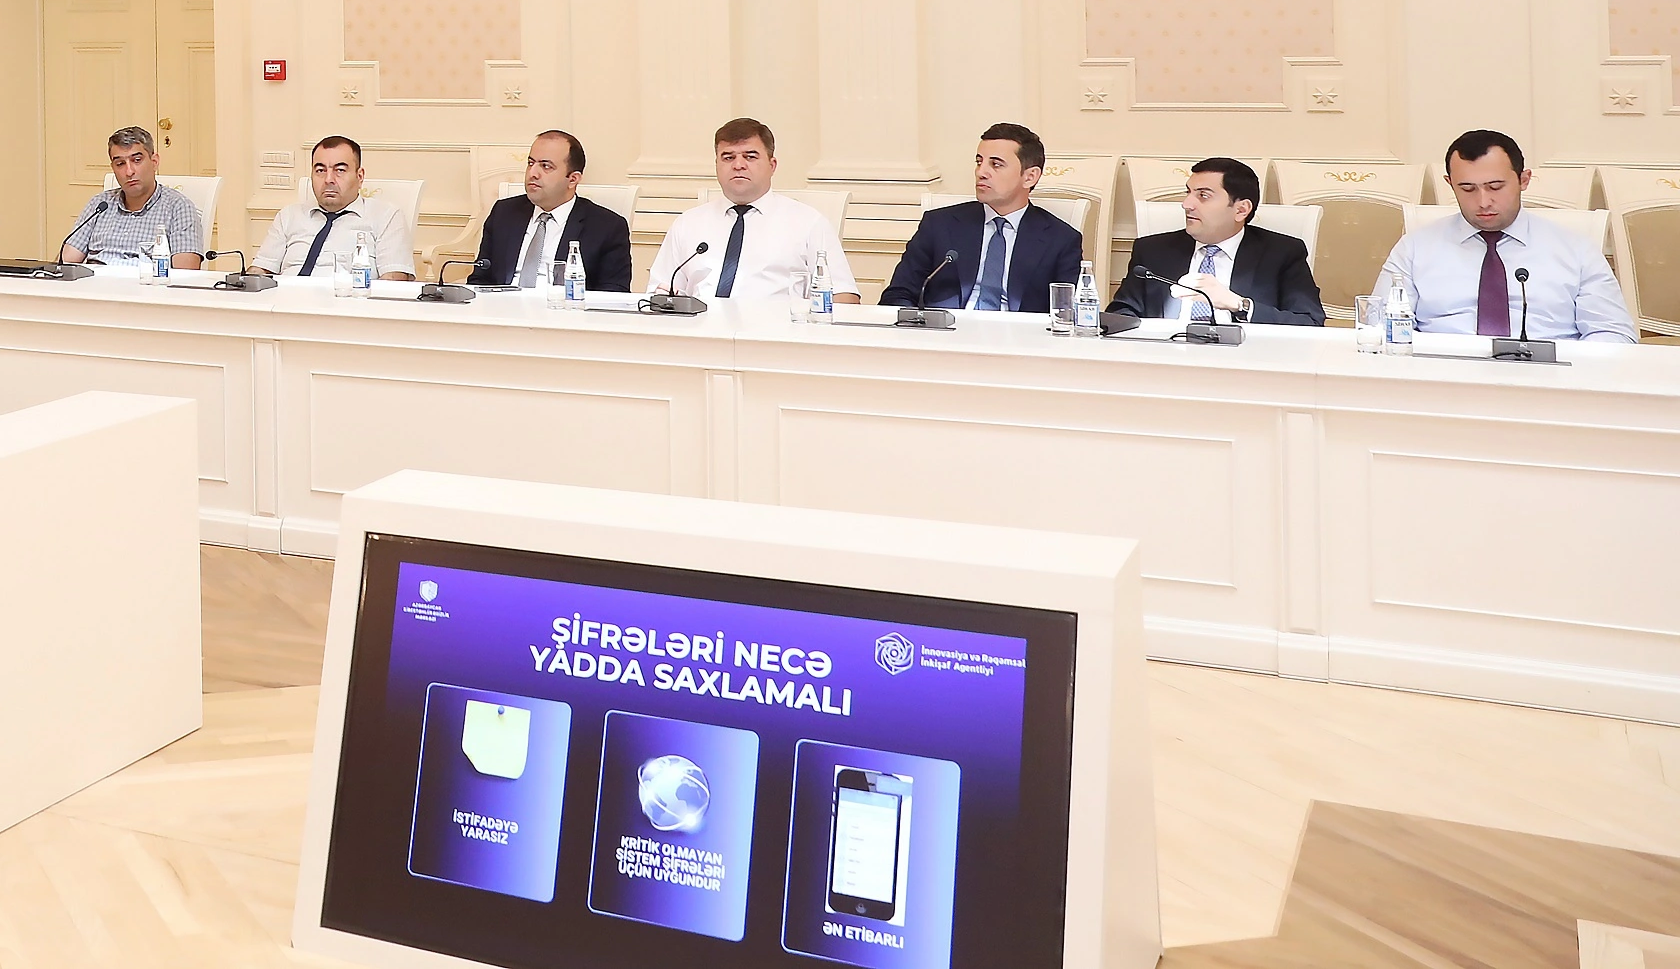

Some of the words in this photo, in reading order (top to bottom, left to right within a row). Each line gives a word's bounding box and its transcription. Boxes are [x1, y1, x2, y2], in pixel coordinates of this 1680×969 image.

[551, 612, 725, 664] ŞİFRƏLƏRİ
[734, 640, 832, 679] NECƏ
[529, 644, 646, 687] YADDA
[653, 663, 852, 716] SAXLAMALI
[460, 824, 509, 845] YARASIZ
[661, 843, 723, 865] OLMAYAN
[822, 921, 843, 938] ƏN
[845, 925, 904, 949] ETİBARLI
